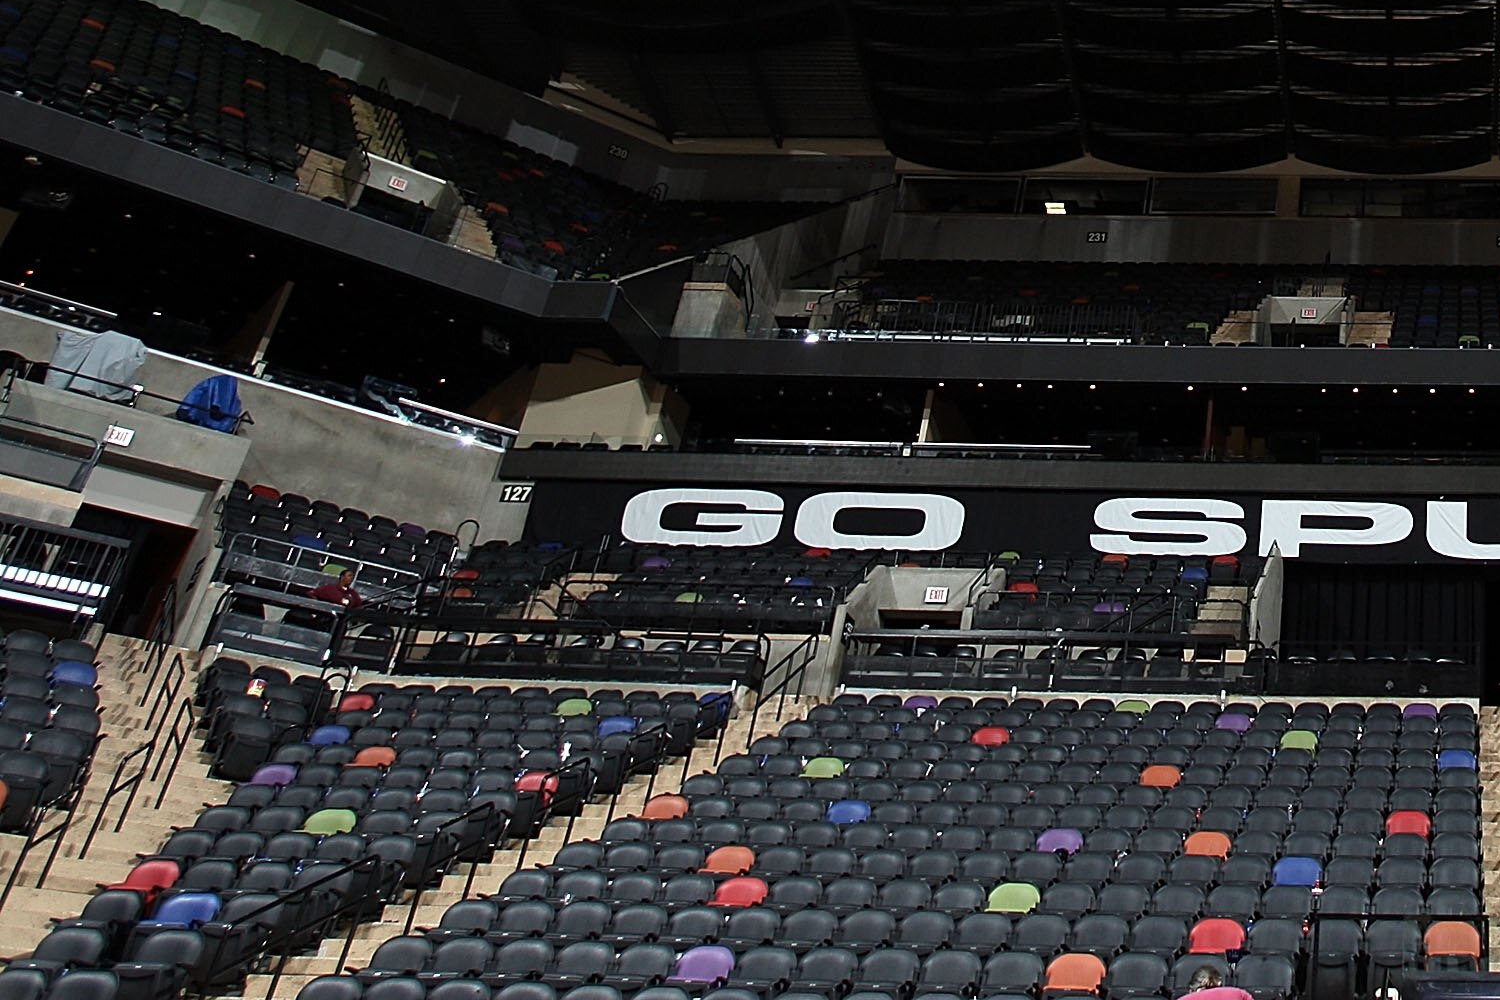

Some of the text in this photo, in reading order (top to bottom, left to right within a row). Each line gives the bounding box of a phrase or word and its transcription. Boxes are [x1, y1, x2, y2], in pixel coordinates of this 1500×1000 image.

[1088, 233, 1107, 242] 231
[108, 428, 129, 442] EXIT
[503, 486, 532, 501] 127
[620, 488, 966, 551] GO
[929, 590, 945, 600] EXIT
